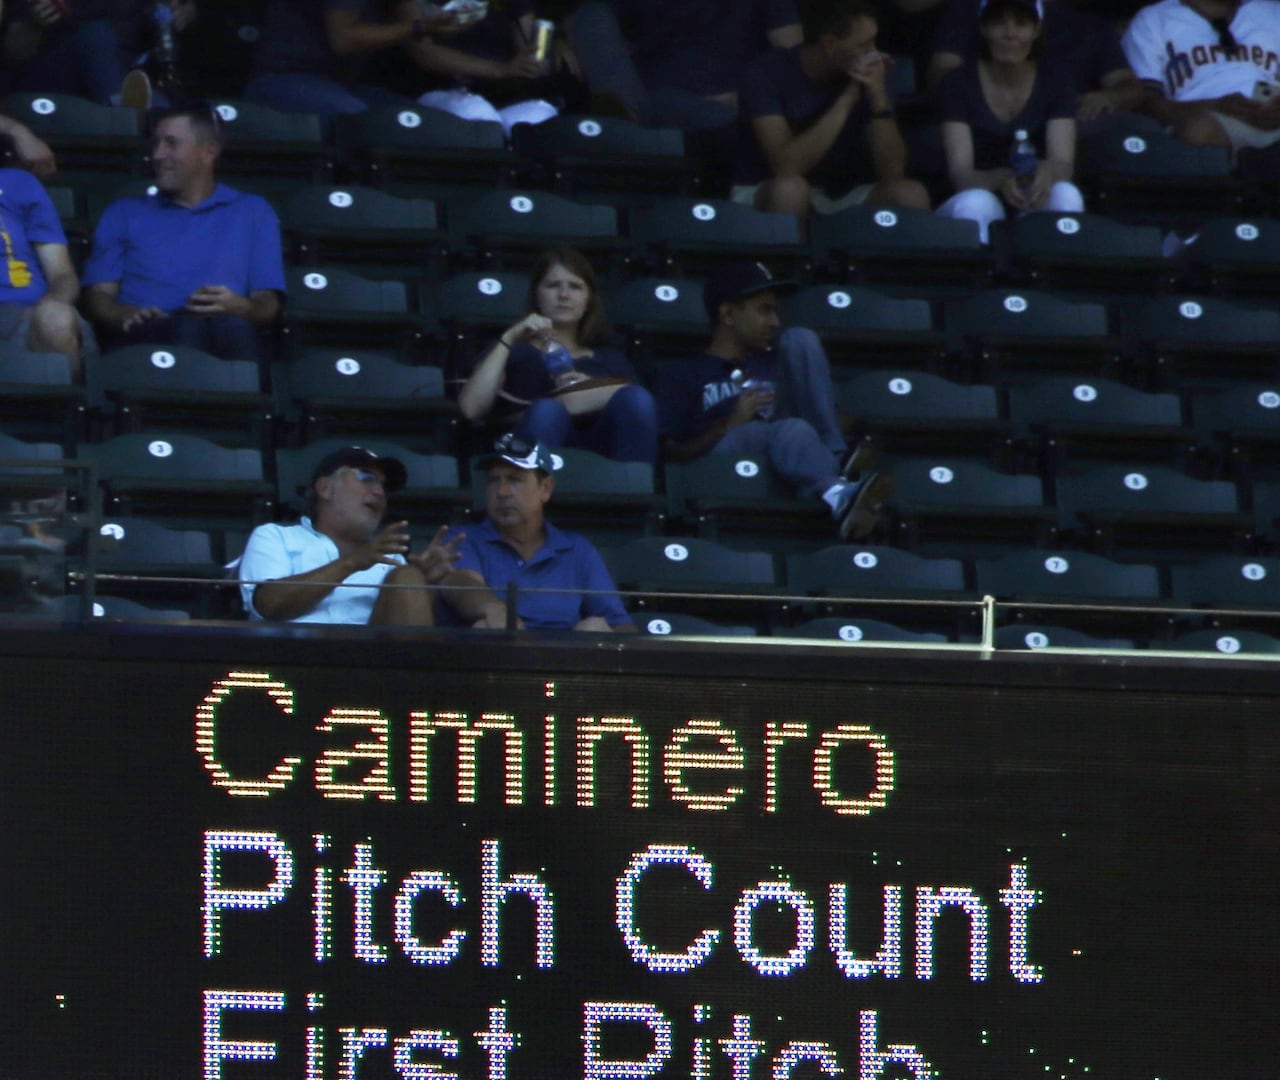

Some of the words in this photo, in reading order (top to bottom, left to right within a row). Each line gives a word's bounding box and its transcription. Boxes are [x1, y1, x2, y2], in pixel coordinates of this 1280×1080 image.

[195, 672, 895, 816] Caminero
[200, 829, 554, 968] Pitch
[616, 844, 1043, 983] Count
